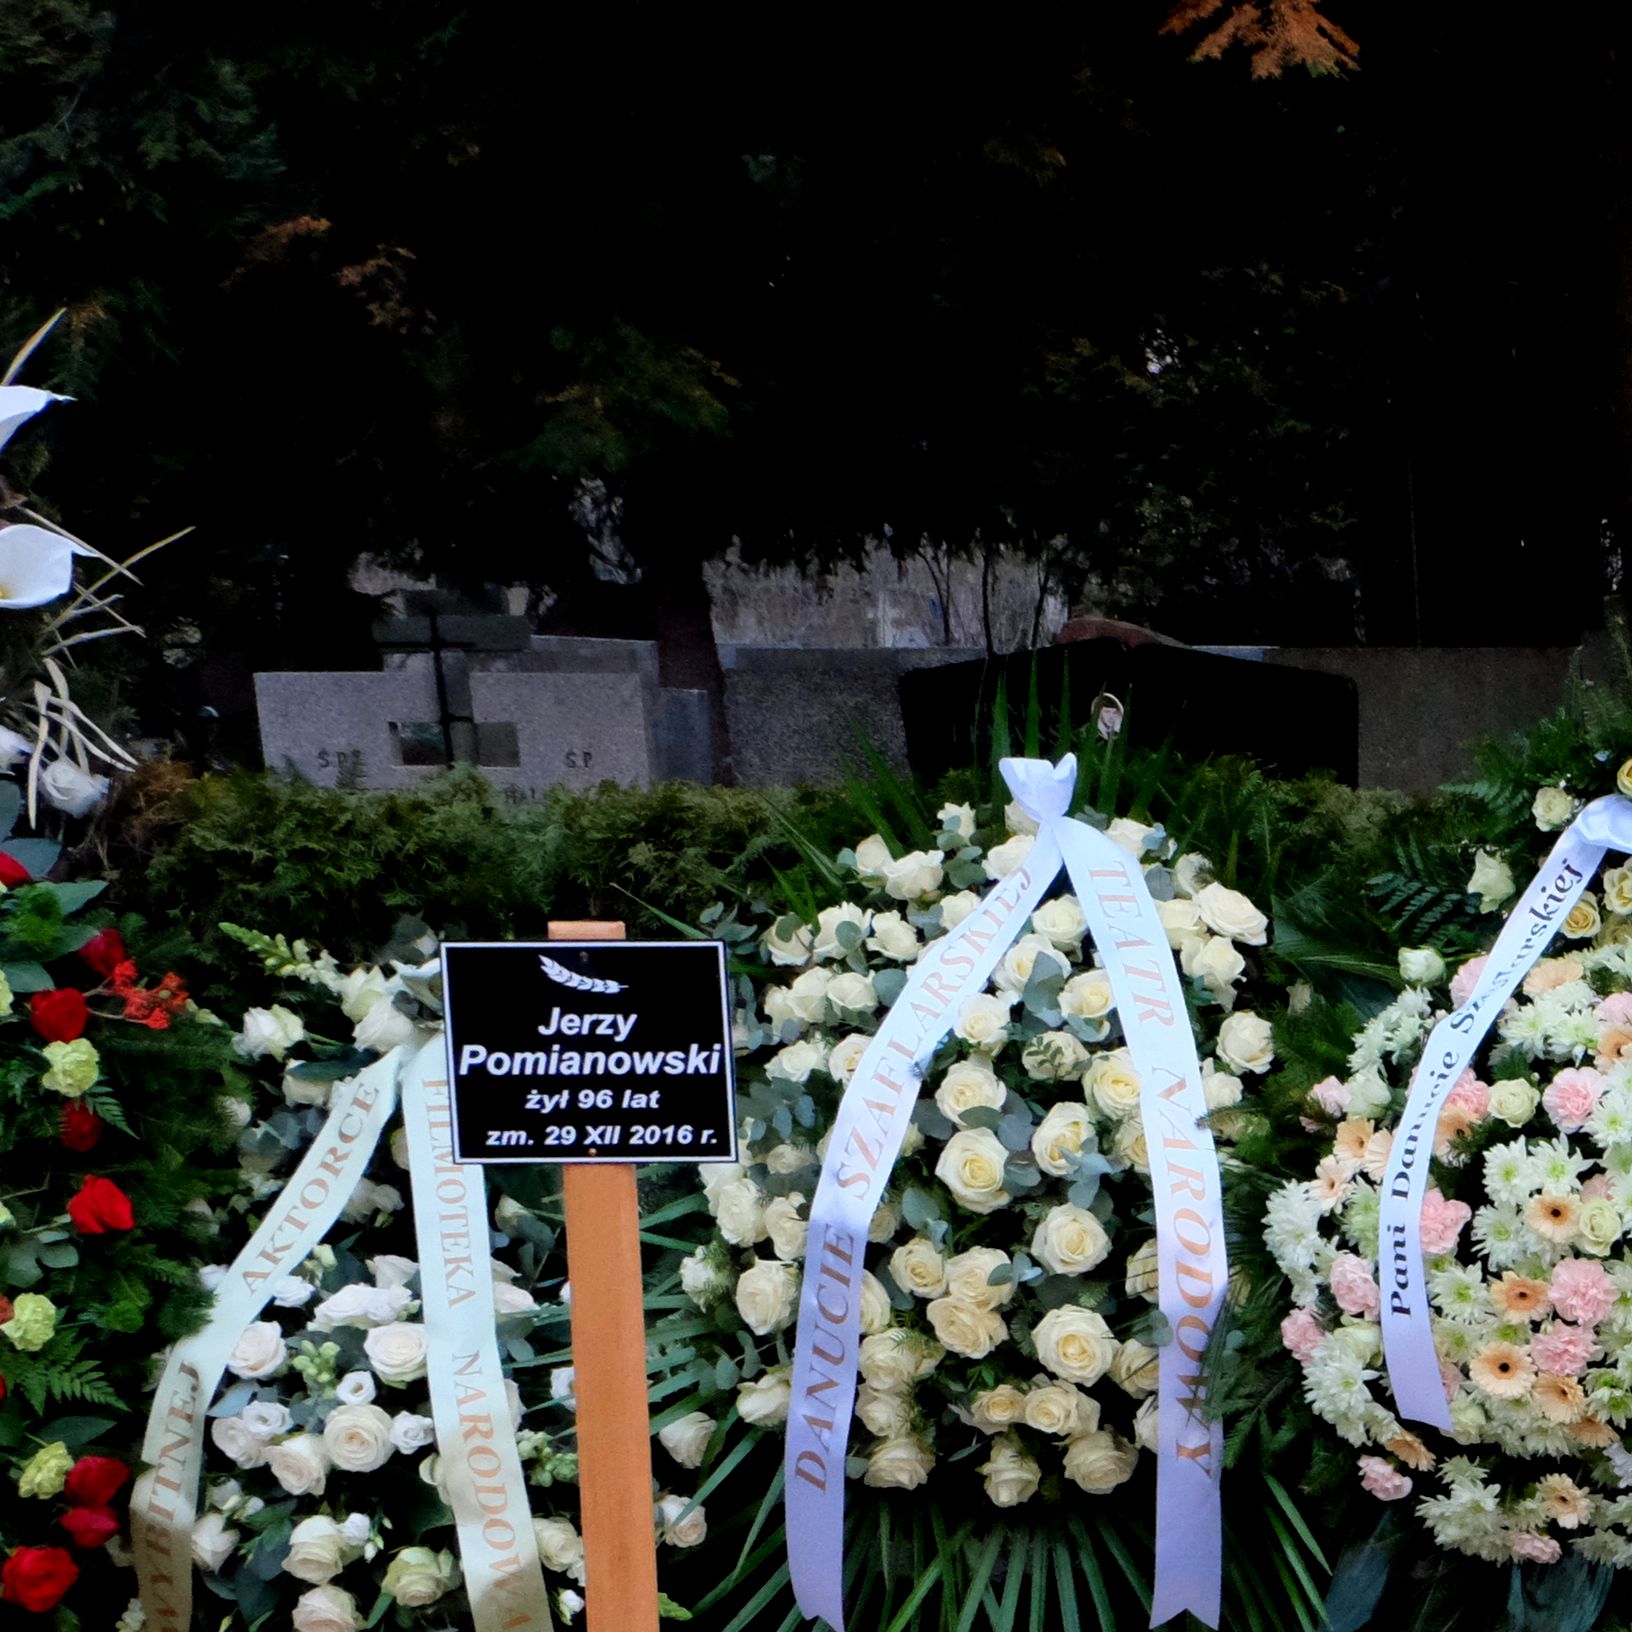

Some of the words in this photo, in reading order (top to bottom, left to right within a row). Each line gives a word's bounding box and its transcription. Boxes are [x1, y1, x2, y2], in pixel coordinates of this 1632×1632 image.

[537, 1006, 638, 1042] Jerzy
[458, 1043, 722, 1076] Pomianowski
[525, 1088, 569, 1113] żył
[578, 1089, 613, 1109] 96
[622, 1089, 661, 1109] lat
[485, 1128, 534, 1145] zm.
[543, 1124, 577, 1145] 29
[583, 1124, 621, 1145] XII
[629, 1124, 694, 1145] 2016
[700, 1127, 718, 1144] r.
[241, 1082, 382, 1297] AKTORCE
[793, 1222, 857, 1493] DANUCIE
[837, 863, 1035, 1203] SZAFLARSKIEJ
[1087, 858, 1176, 1031] TEATR
[1151, 1064, 1214, 1482] NARODOWY
[1388, 1223, 1412, 1319] Pani
